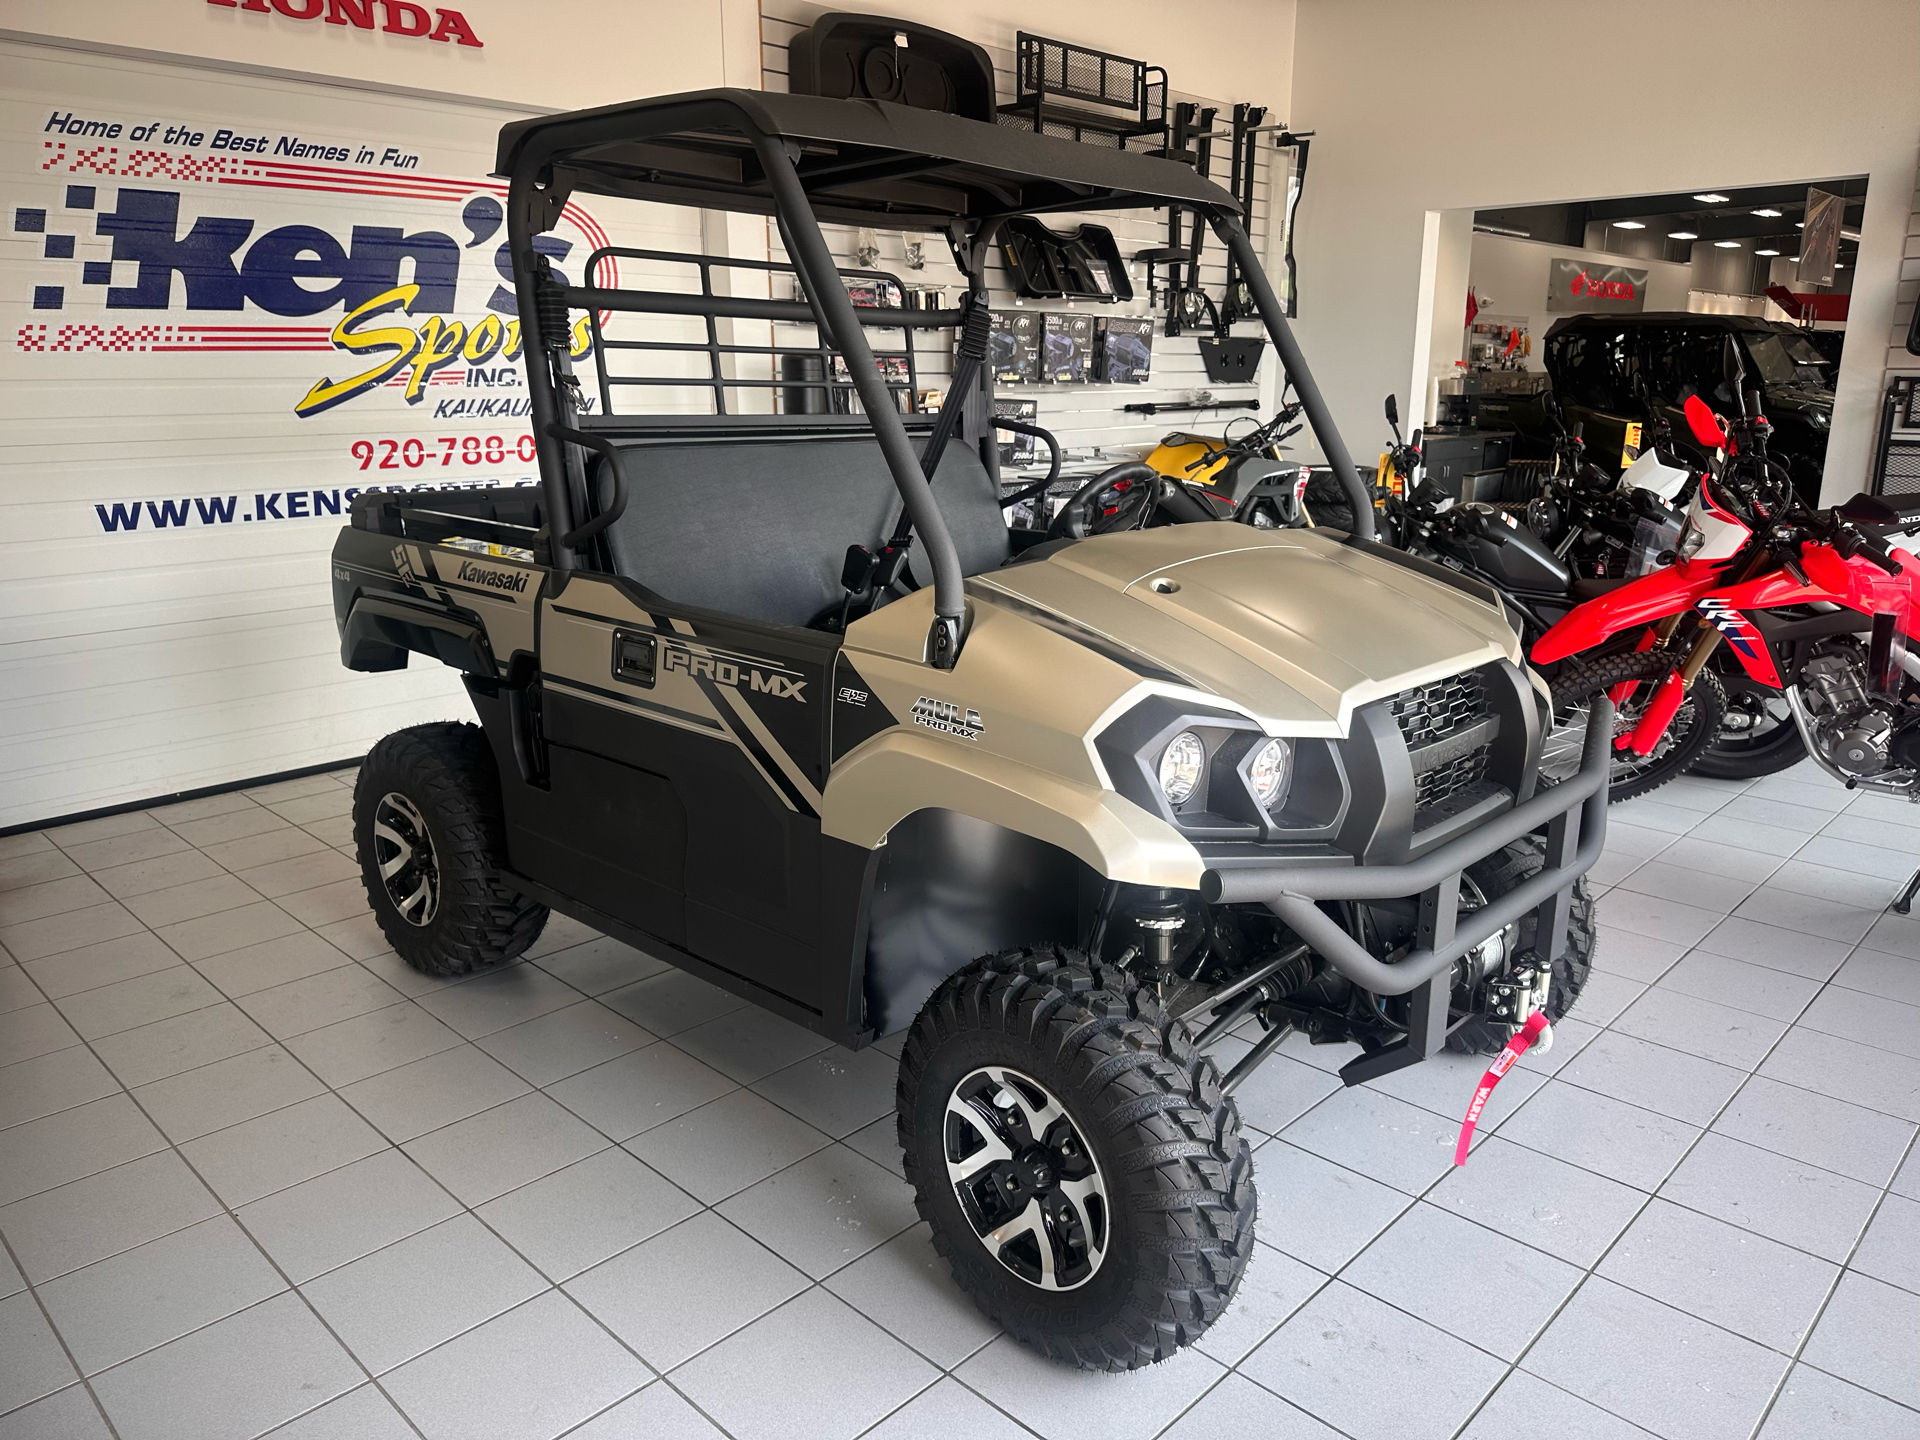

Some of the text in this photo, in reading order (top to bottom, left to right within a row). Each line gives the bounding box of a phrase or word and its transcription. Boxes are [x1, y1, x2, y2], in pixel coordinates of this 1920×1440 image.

[207, 0, 484, 48] ONDA
[45, 111, 420, 170] Home of the Best Names in Fun
[1586, 279, 1634, 300] HONDA
[466, 368, 523, 388] INC.
[350, 434, 538, 471] 920-788-0
[334, 568, 351, 582] 4x4
[457, 560, 531, 593] Kawasaki
[1697, 598, 1750, 632] CRF
[664, 648, 809, 704] PRO-MX
[838, 687, 868, 703] EPS
[909, 696, 986, 733] MULE
[914, 715, 978, 741] PRO-MX
[1467, 1086, 1491, 1122] WARN
